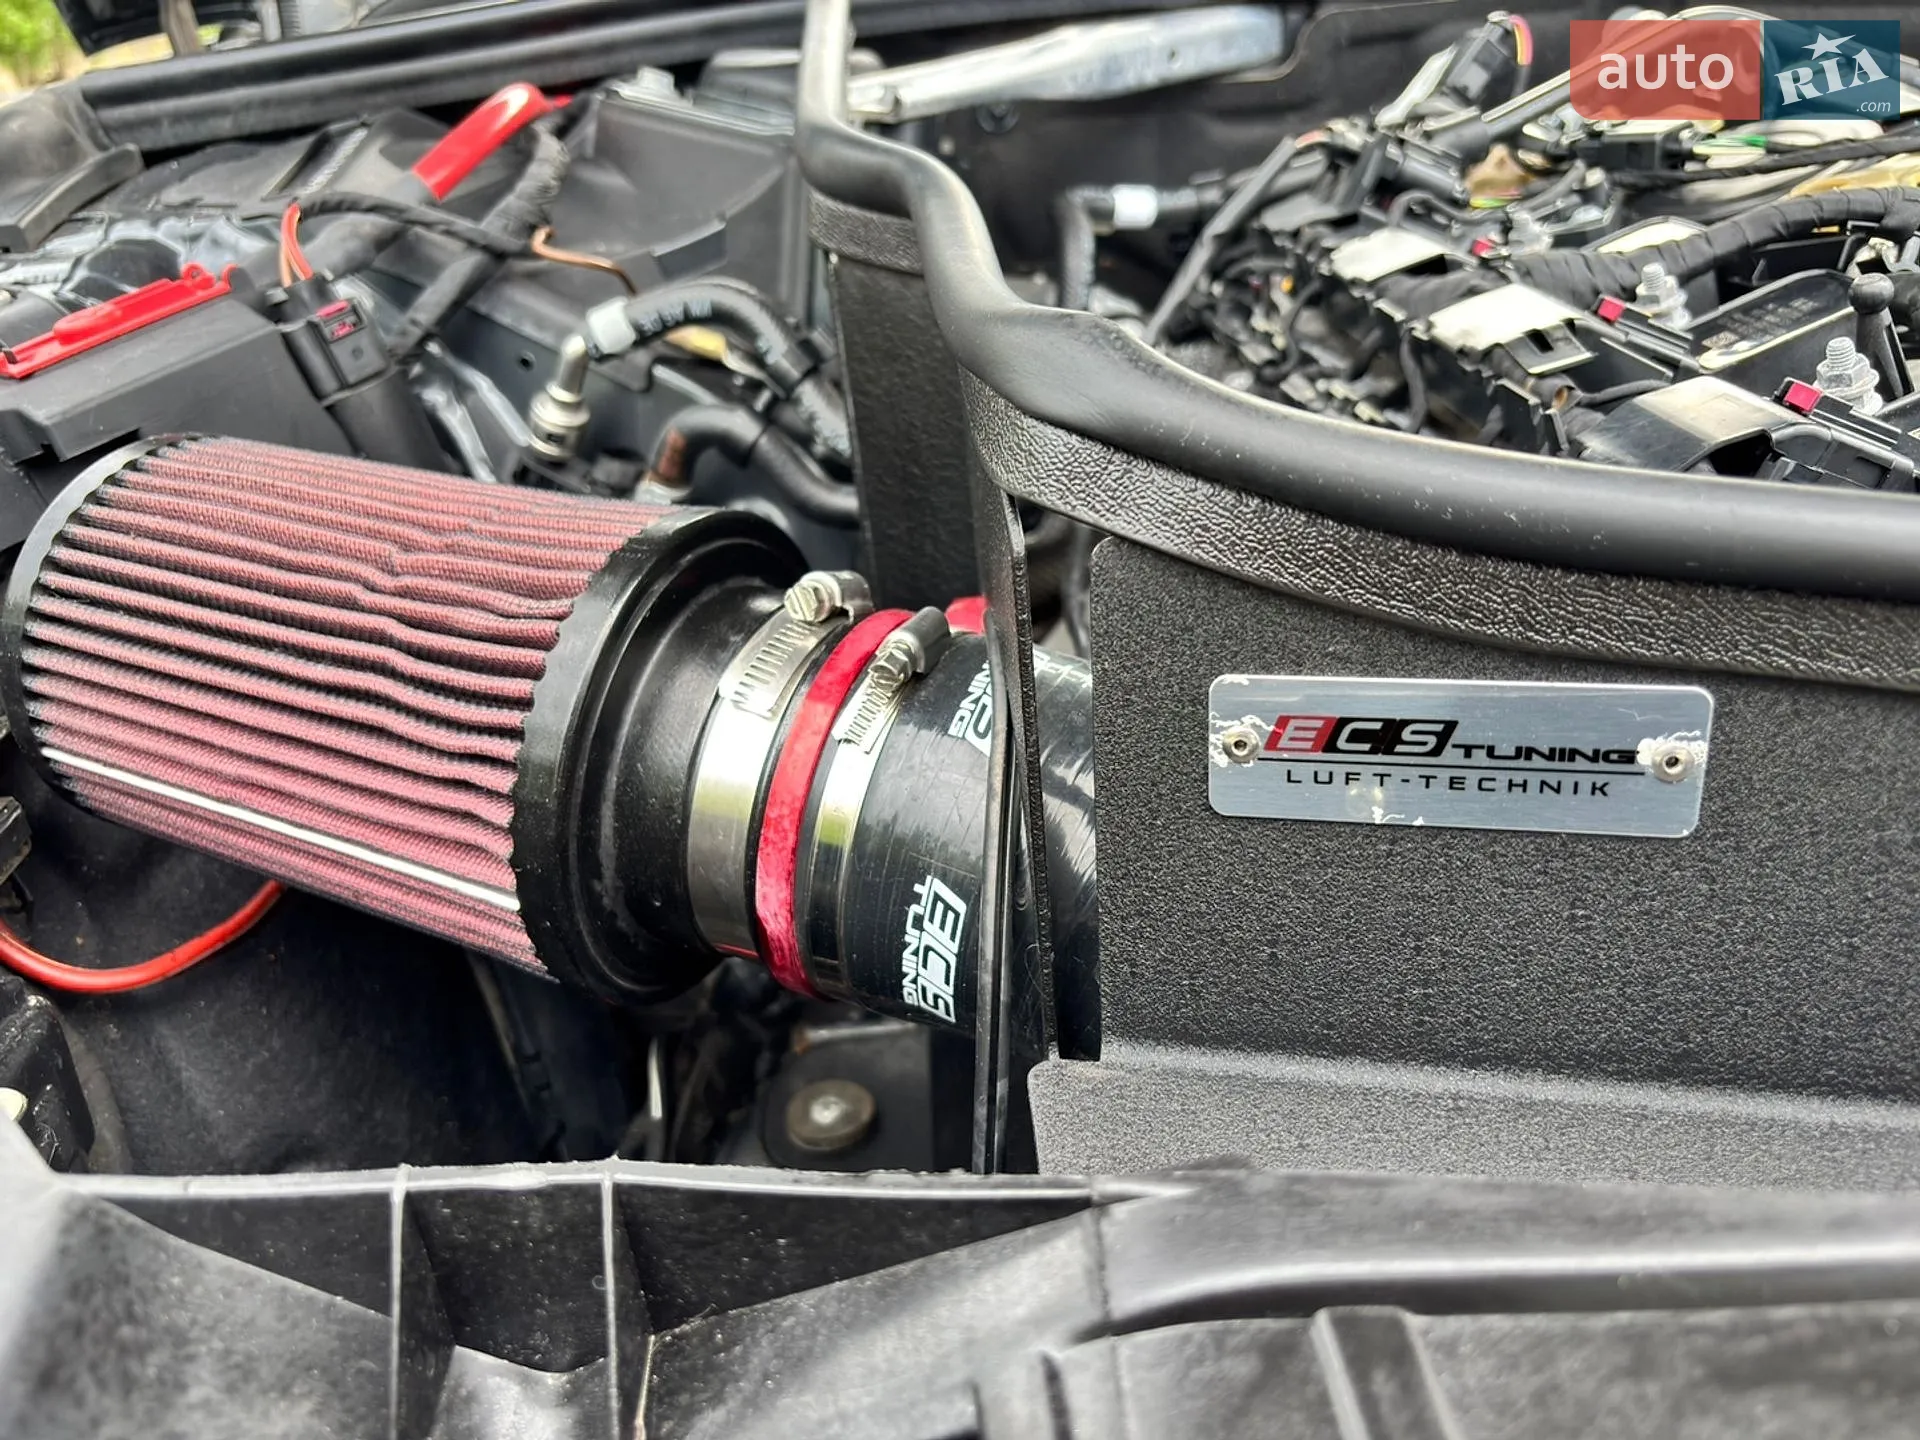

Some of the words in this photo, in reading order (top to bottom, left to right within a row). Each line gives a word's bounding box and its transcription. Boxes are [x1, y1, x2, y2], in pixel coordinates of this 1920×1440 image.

[1266, 715, 1455, 757] ECS
[1452, 743, 1640, 765] TUNING
[1286, 769, 1610, 797] LUFT-TECHNIK
[901, 875, 932, 1006] TUNING
[918, 877, 967, 1023] ECS
